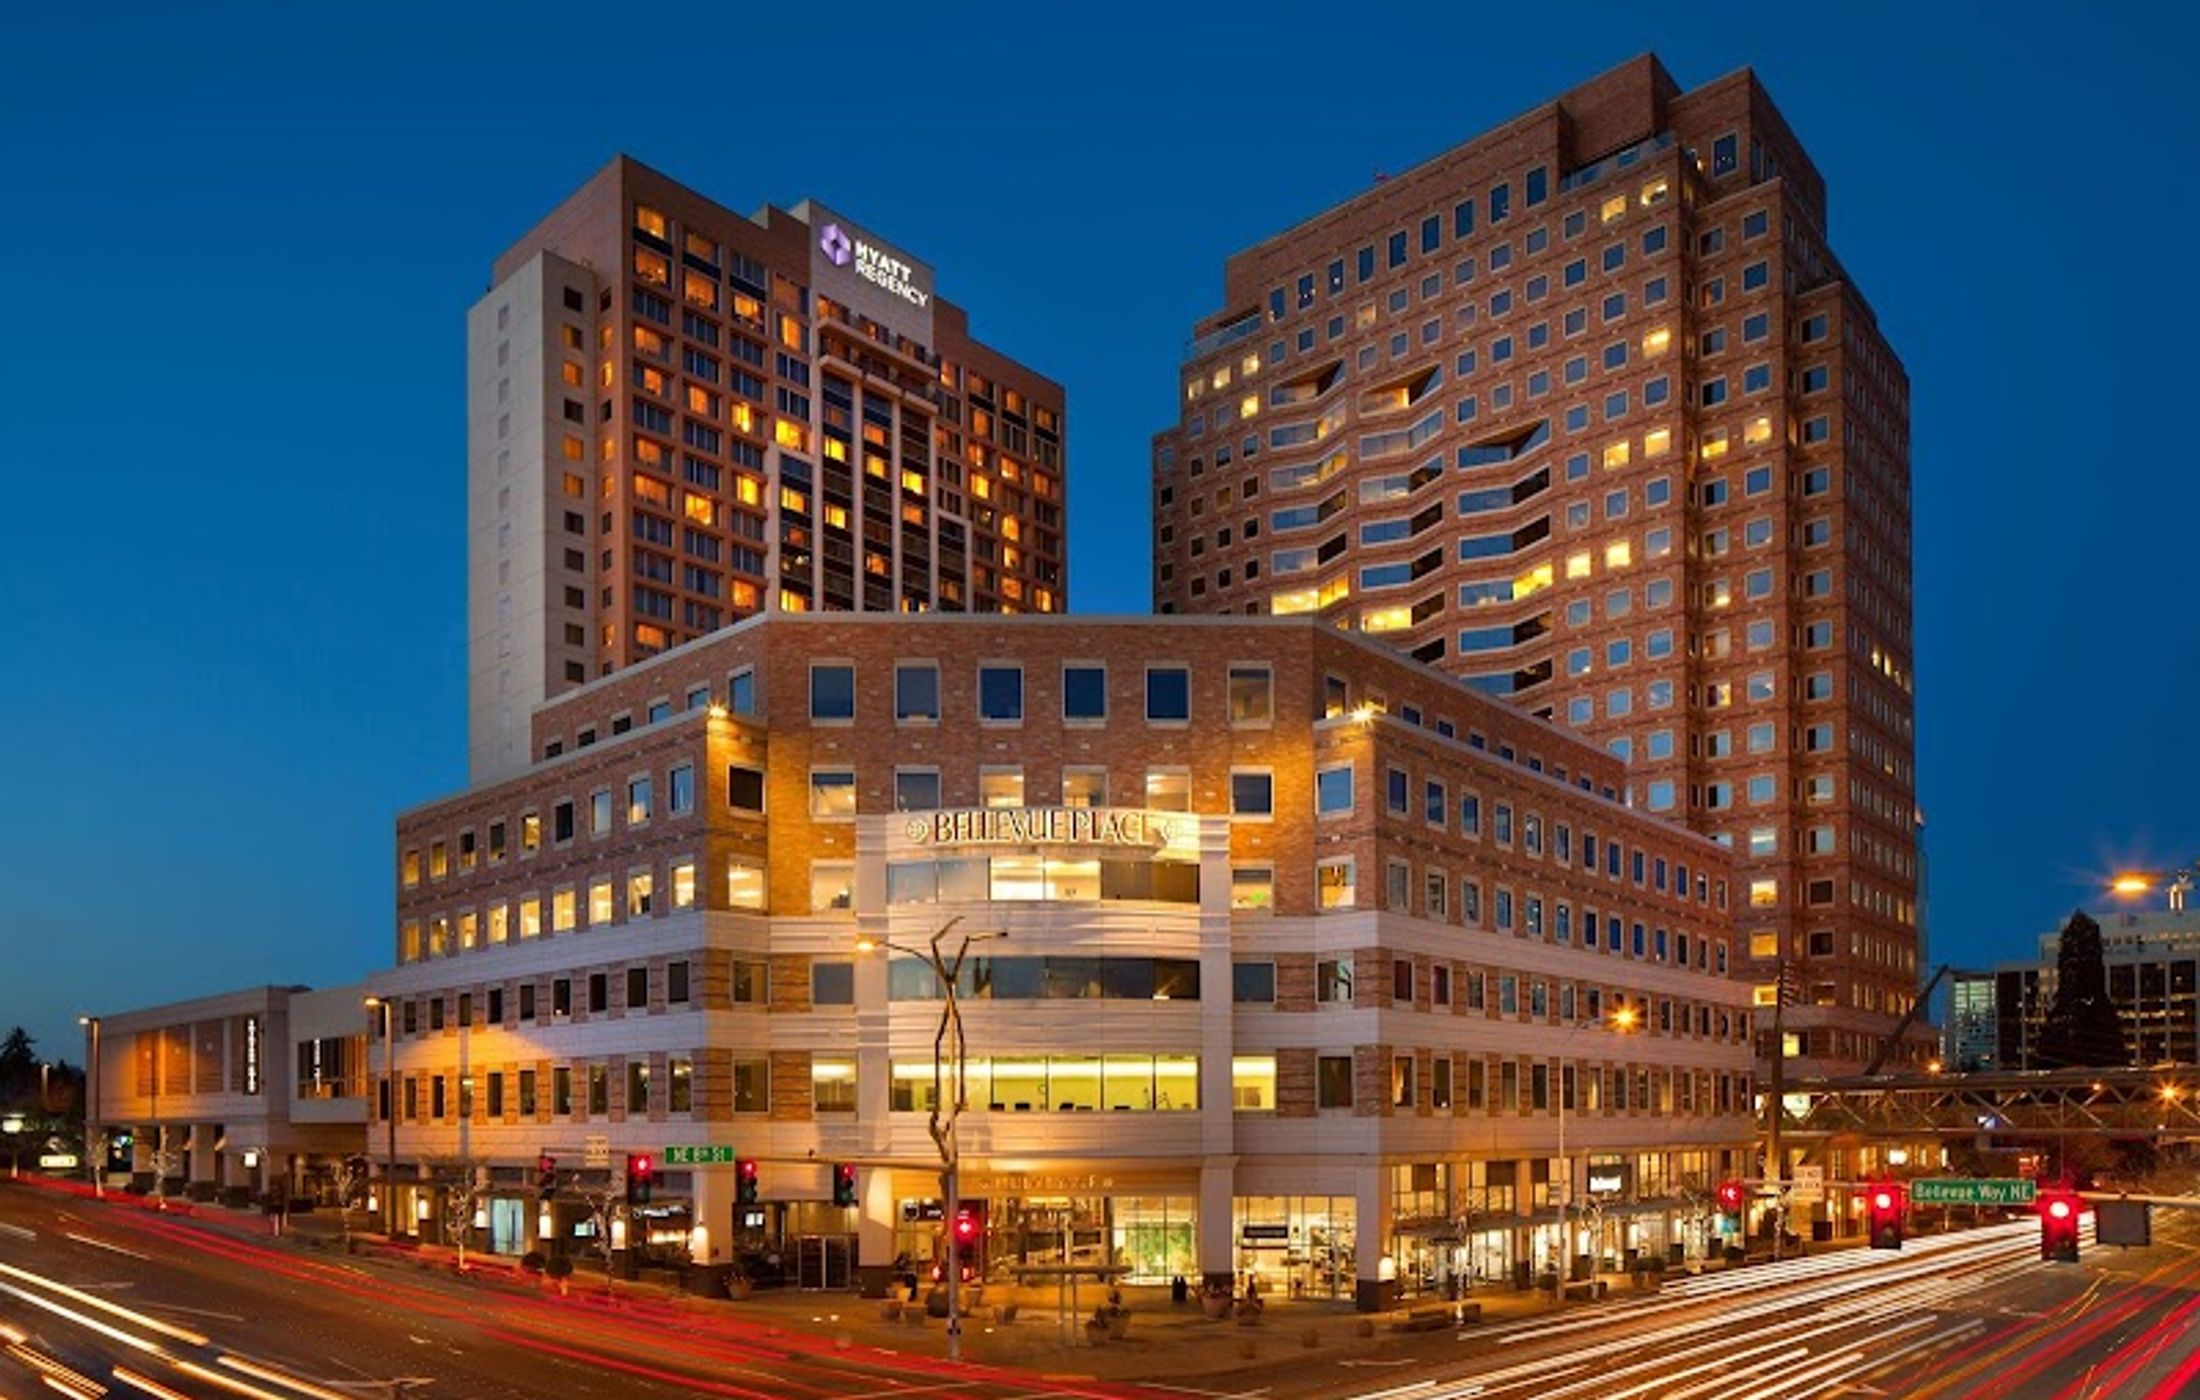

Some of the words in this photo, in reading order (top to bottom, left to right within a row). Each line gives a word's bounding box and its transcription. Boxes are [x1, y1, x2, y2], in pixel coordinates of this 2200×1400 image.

[855, 240, 911, 282] HYATT
[855, 258, 928, 306] REGENCY
[935, 809, 1066, 844] BELLEVUE
[674, 1147, 688, 1162] NE
[1915, 1182, 1974, 1199] Bellevue
[1979, 1183, 2006, 1202] Way
[2011, 1183, 2032, 1200] NE
